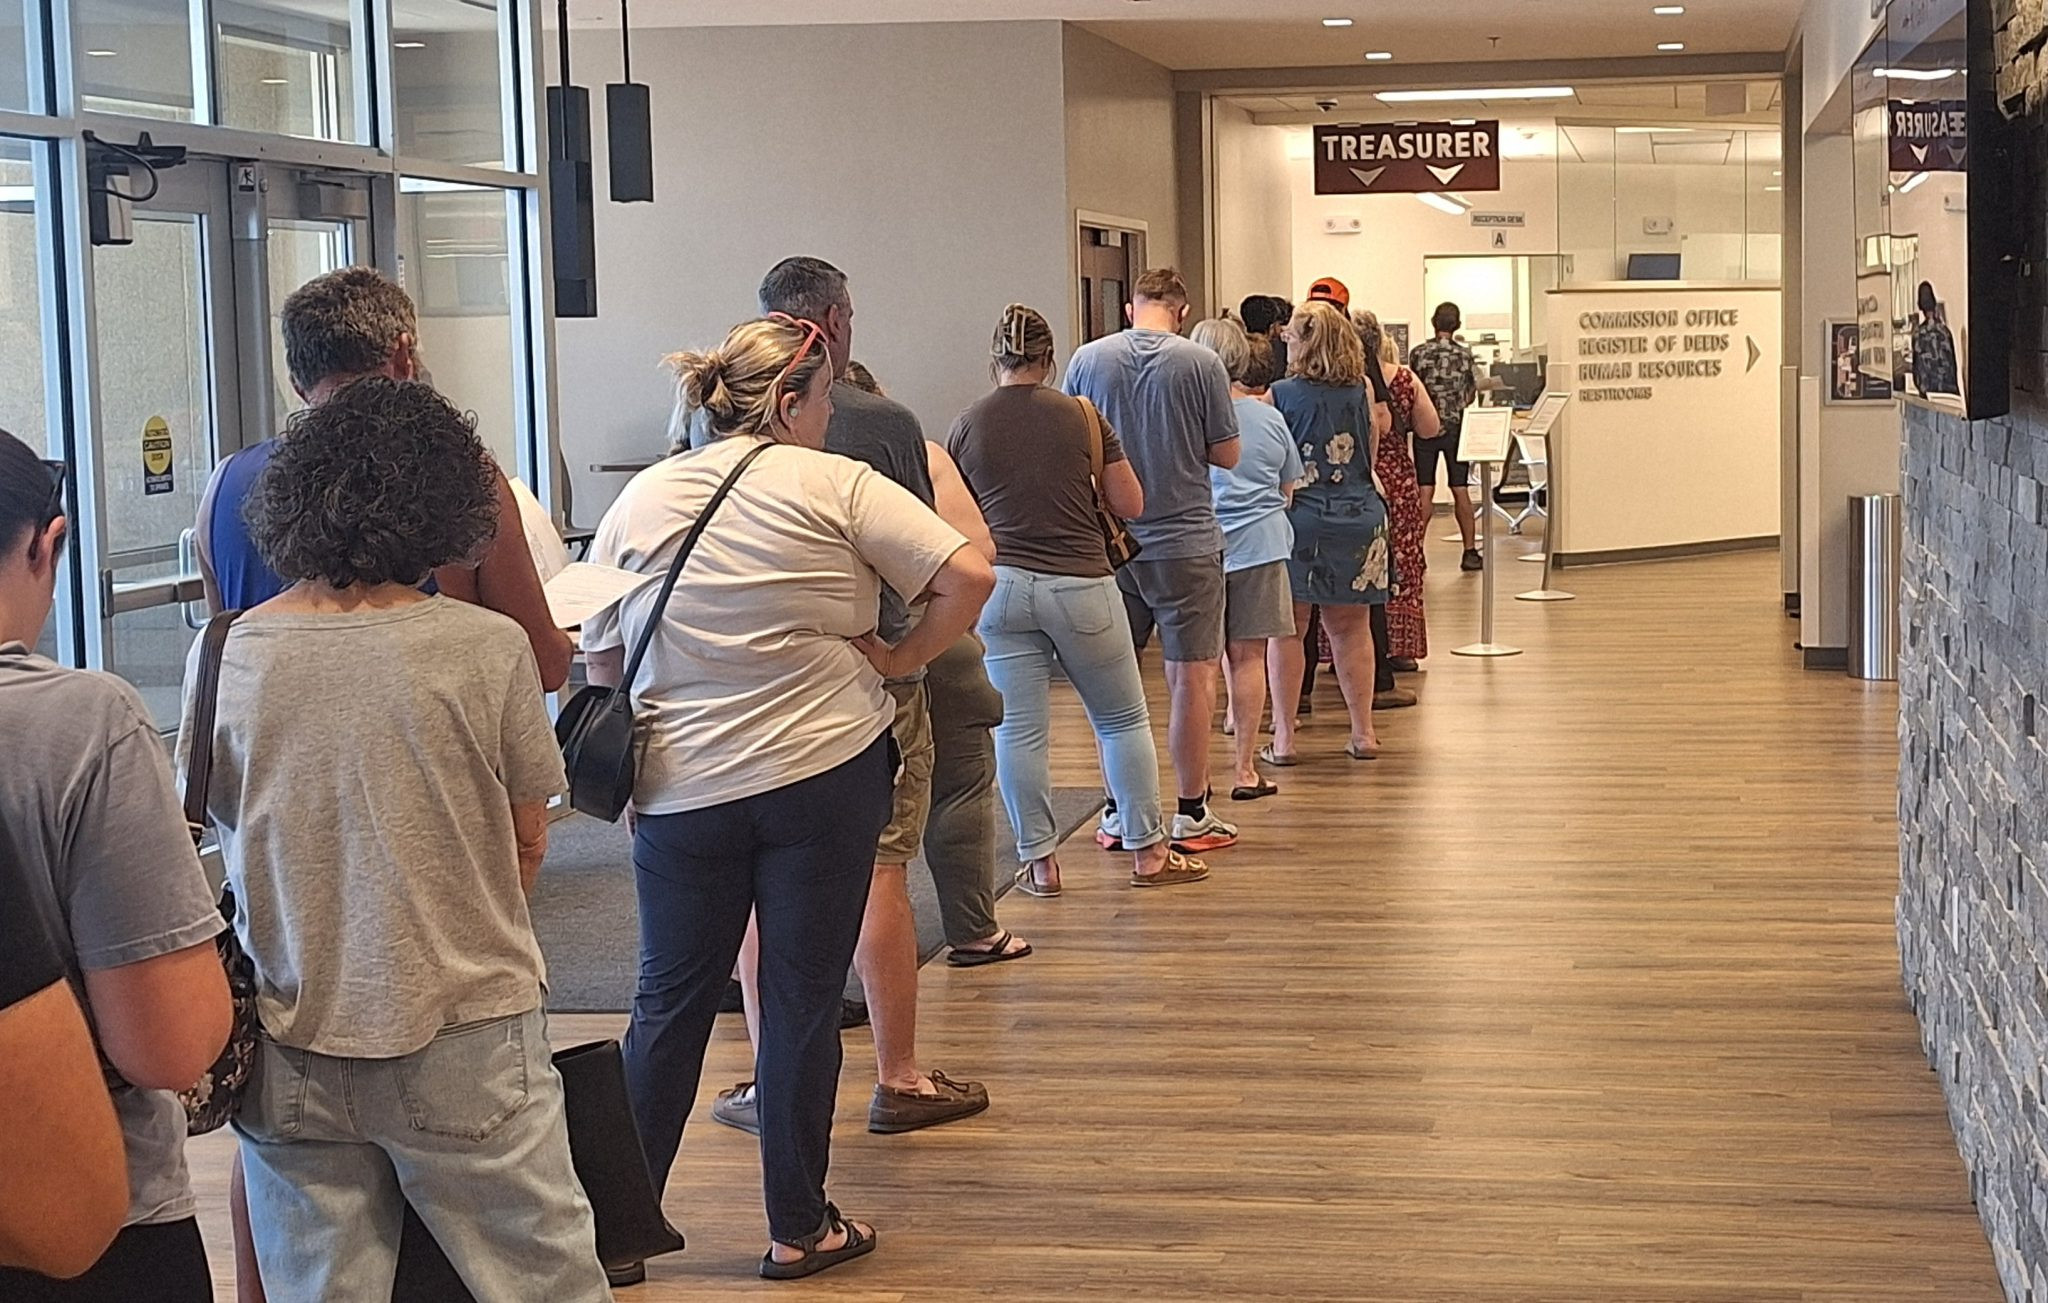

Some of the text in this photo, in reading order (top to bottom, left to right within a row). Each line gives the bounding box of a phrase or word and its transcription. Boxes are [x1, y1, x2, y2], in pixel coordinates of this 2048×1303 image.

[1321, 131, 1491, 161] TREASURER
[1494, 232, 1505, 246] A
[1578, 309, 1739, 330] COMMISSION OFFICE
[1578, 334, 1729, 355] REGISTER OF DEEDS
[1578, 359, 1722, 381] HUMAN RESOURCES
[1578, 387, 1652, 402] RESTROOMS
